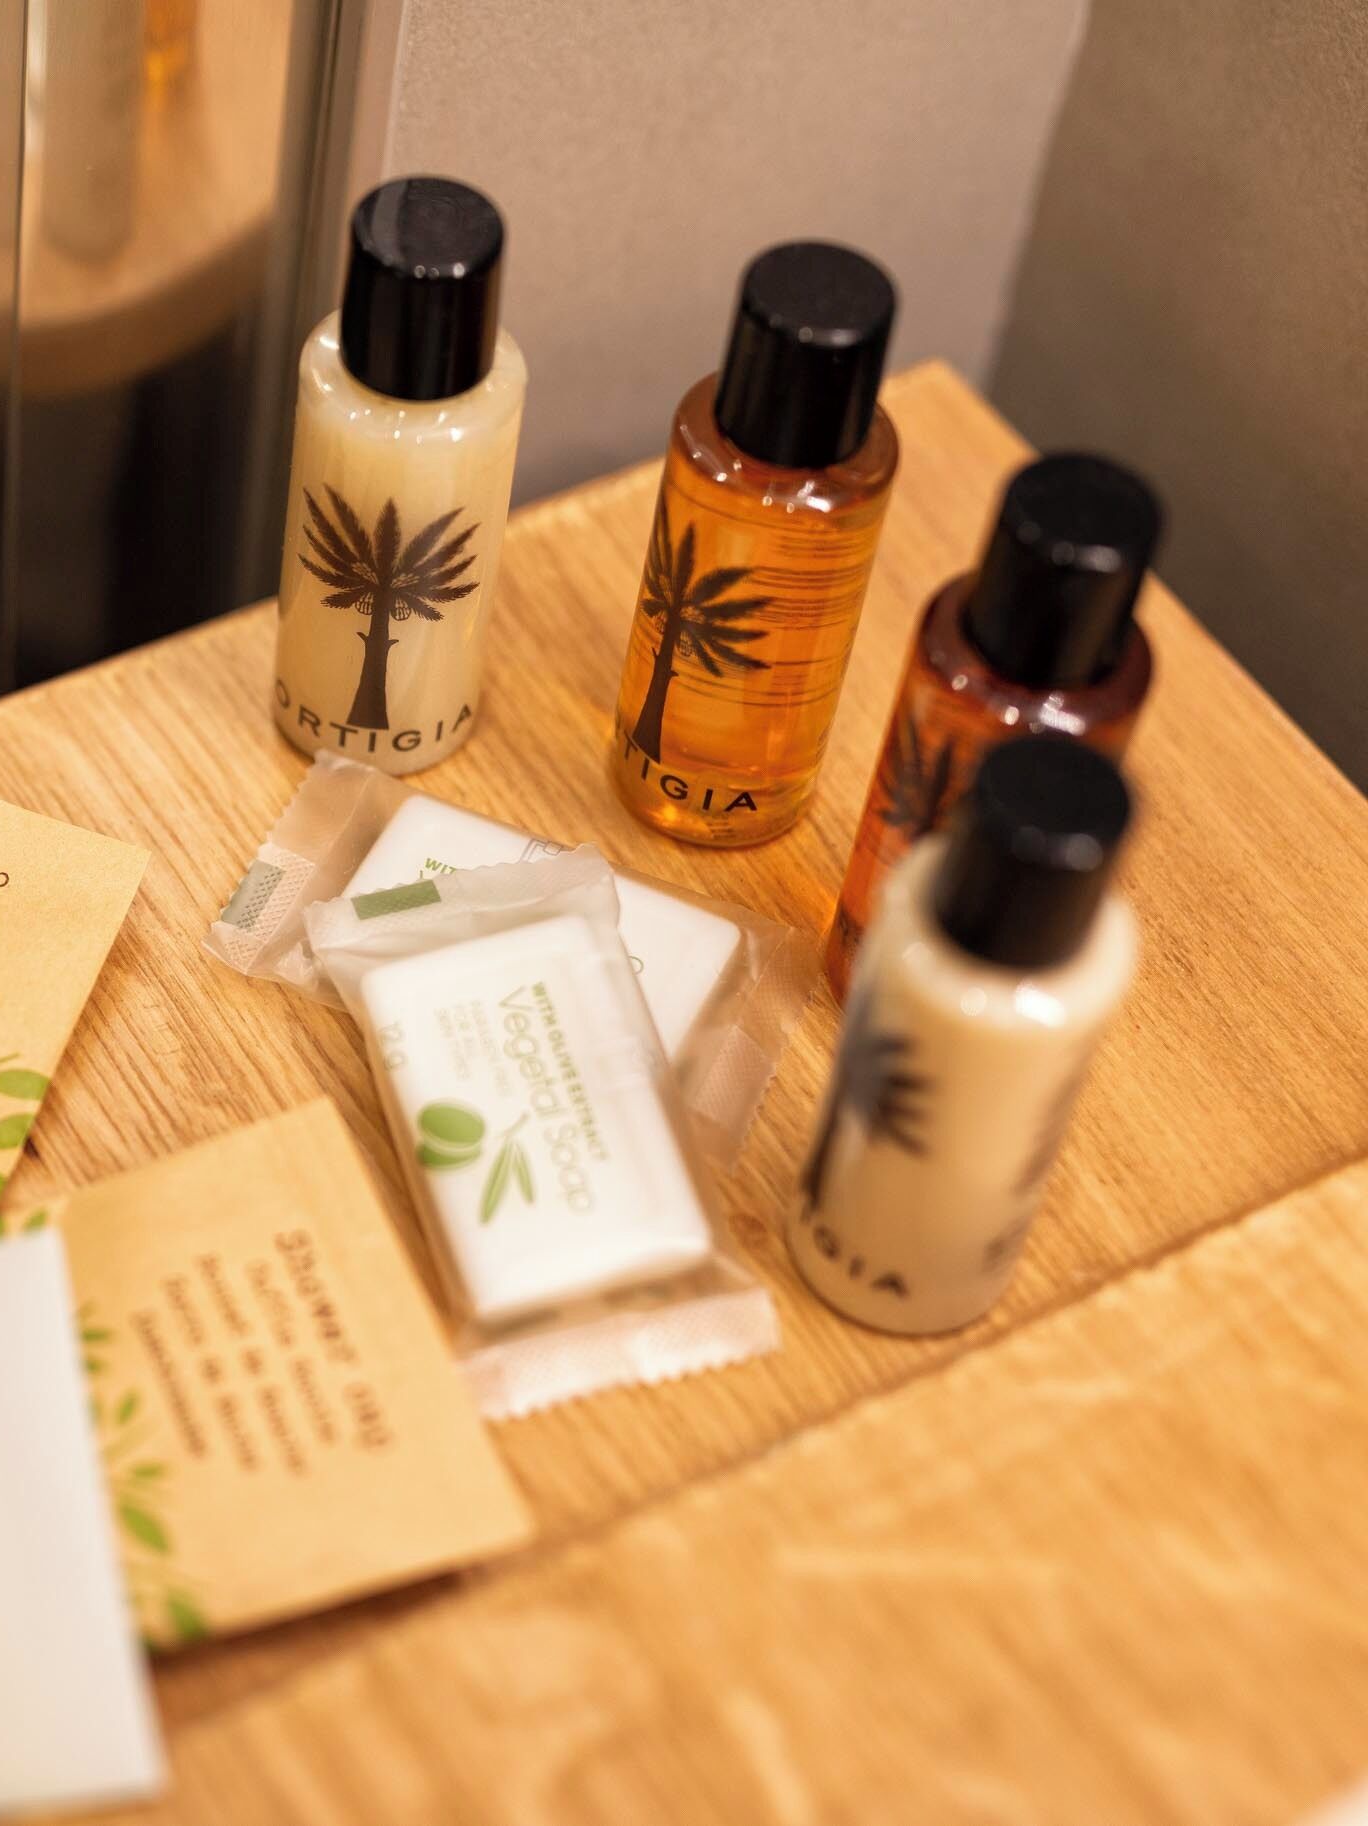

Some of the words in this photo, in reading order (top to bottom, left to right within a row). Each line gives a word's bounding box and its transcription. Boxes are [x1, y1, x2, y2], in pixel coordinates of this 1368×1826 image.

[275, 678, 473, 753] ORTIGIA
[620, 720, 757, 811] TIGIA
[498, 985, 569, 1118] Vegetal
